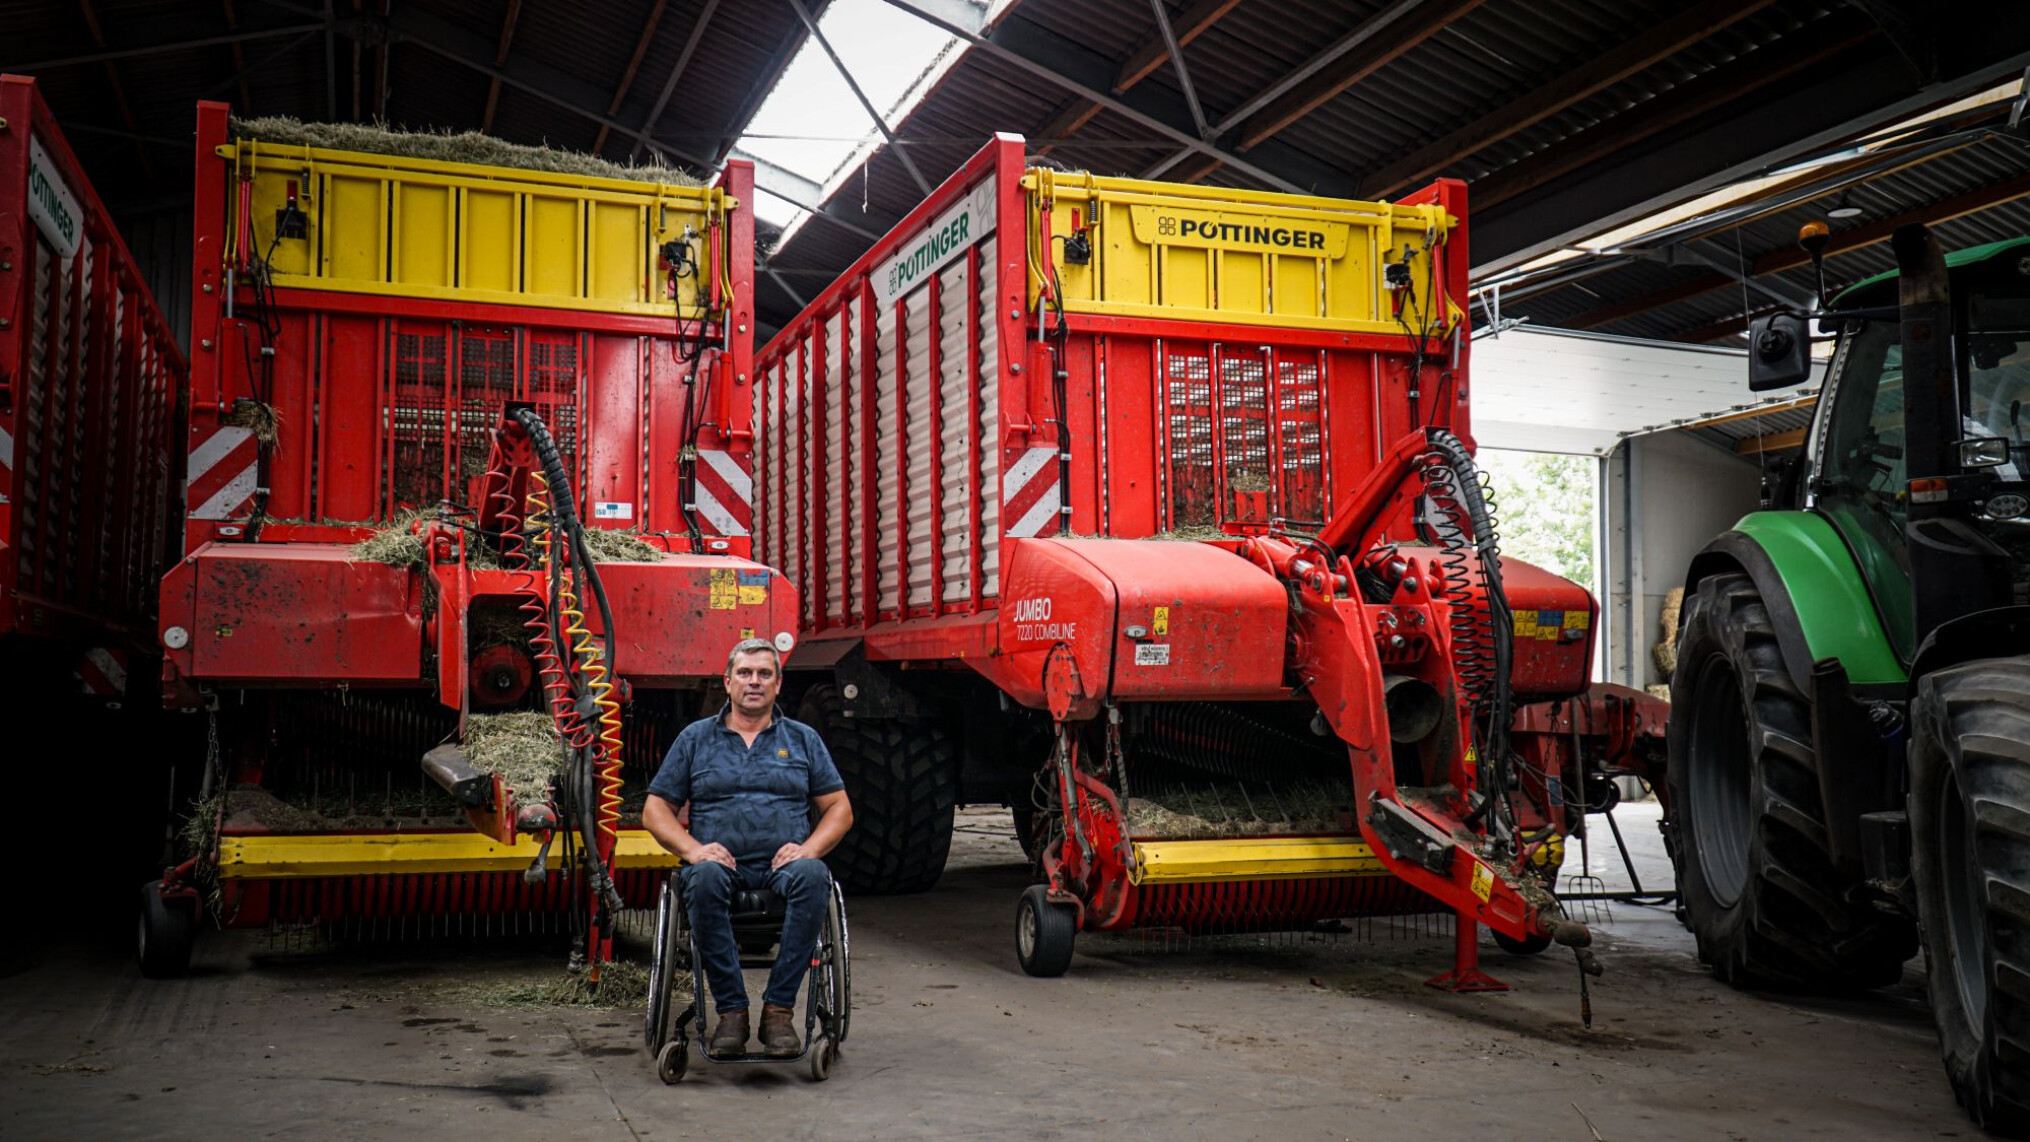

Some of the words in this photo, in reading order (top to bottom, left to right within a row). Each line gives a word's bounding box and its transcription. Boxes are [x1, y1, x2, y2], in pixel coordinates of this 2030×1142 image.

[1013, 597, 1052, 622] JUMBO
[1017, 624, 1033, 641] 7220
[1034, 622, 1077, 640] COMBILINE
